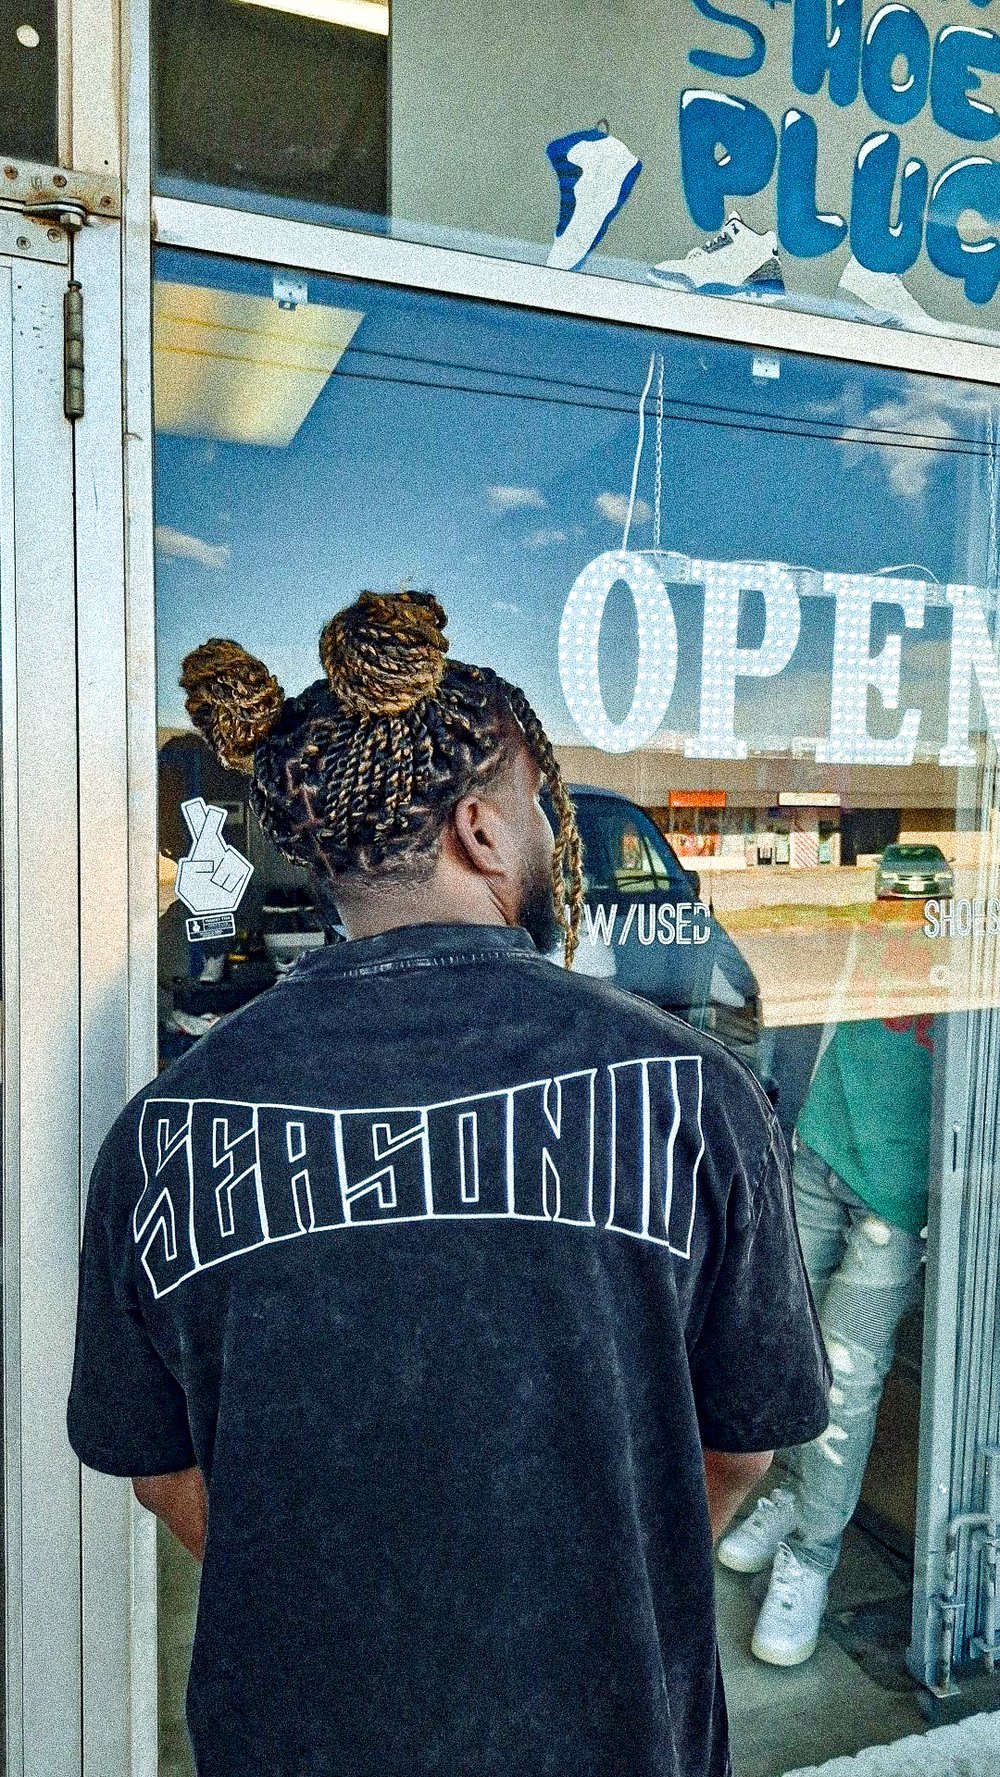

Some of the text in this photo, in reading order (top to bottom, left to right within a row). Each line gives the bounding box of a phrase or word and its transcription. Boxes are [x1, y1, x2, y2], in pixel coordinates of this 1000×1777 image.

[679, 88, 1000, 306] PLUG
[558, 550, 1000, 766] OPEN
[564, 899, 1000, 946] W/USED SHOES
[133, 1068, 597, 1300] SEASON
